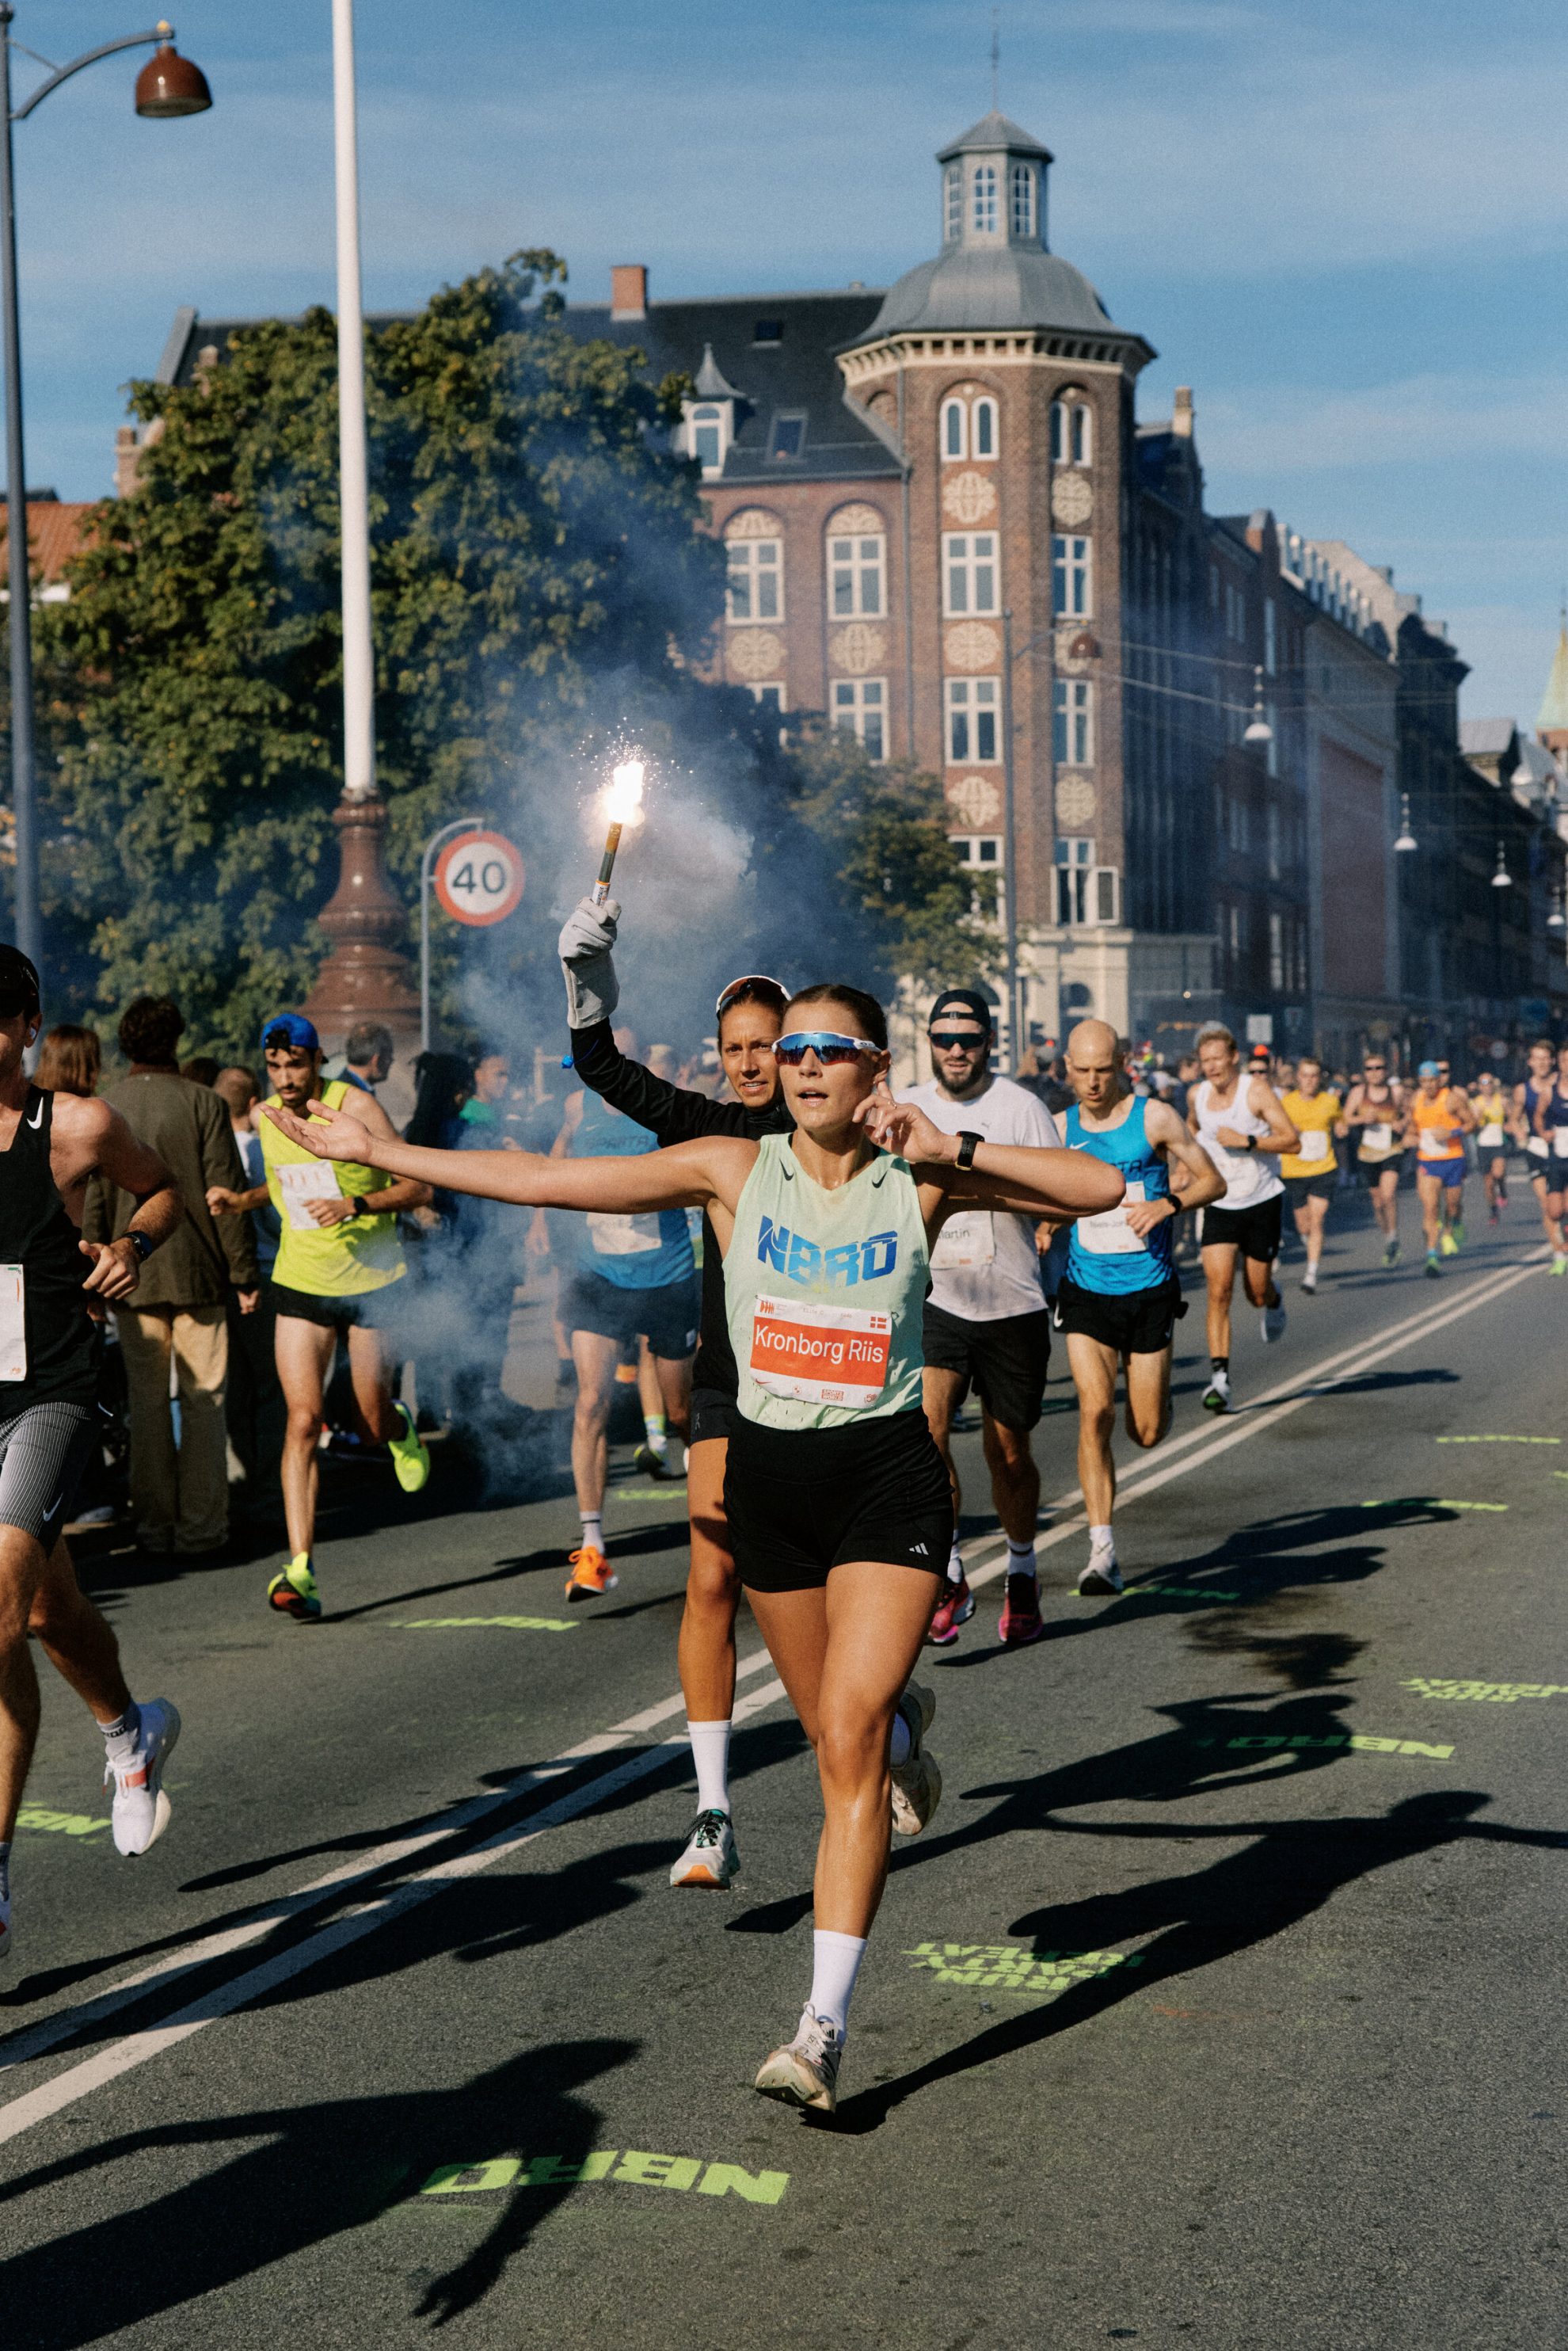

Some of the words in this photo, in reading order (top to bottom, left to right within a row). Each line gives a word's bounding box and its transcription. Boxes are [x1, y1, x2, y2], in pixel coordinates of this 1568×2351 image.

[453, 862, 505, 894] 40
[757, 1215, 898, 1287] NBRO
[755, 1324, 843, 1365] Kronborg
[849, 1339, 884, 1363] Riis
[1227, 1735, 1456, 1759] NBRO
[909, 1956, 1112, 1979] PARTY
[931, 1969, 1071, 1991] RUN
[420, 2150, 790, 2205] NBRO
